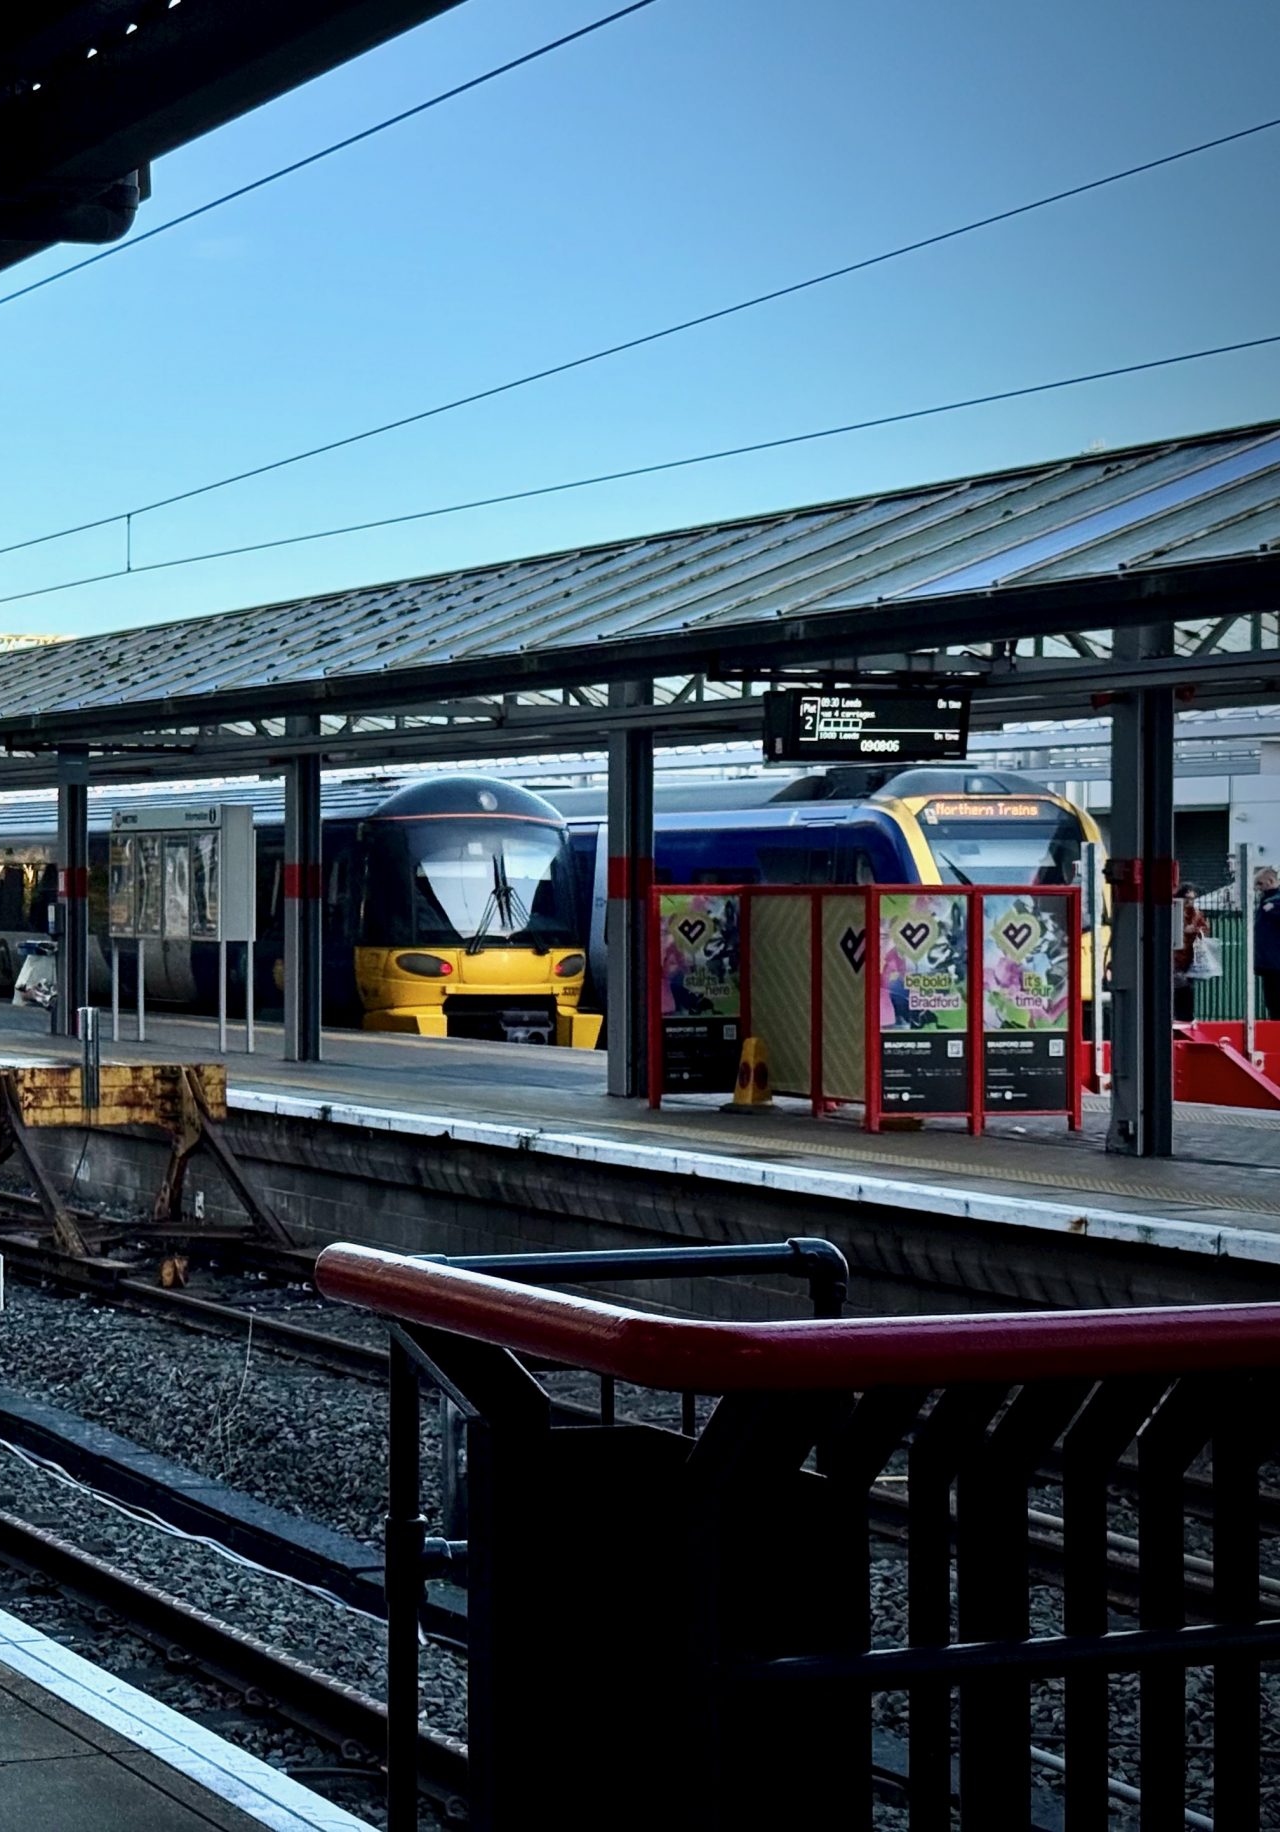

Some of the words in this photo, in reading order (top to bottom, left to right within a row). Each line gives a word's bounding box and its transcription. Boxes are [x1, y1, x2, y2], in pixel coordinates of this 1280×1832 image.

[804, 716, 814, 730] 2
[935, 802, 994, 816] Northern
[997, 803, 1039, 816] Trains
[905, 975, 920, 988] be
[1024, 973, 1042, 987] it's
[910, 995, 960, 1008] Bradford
[1015, 996, 1043, 1007] time
